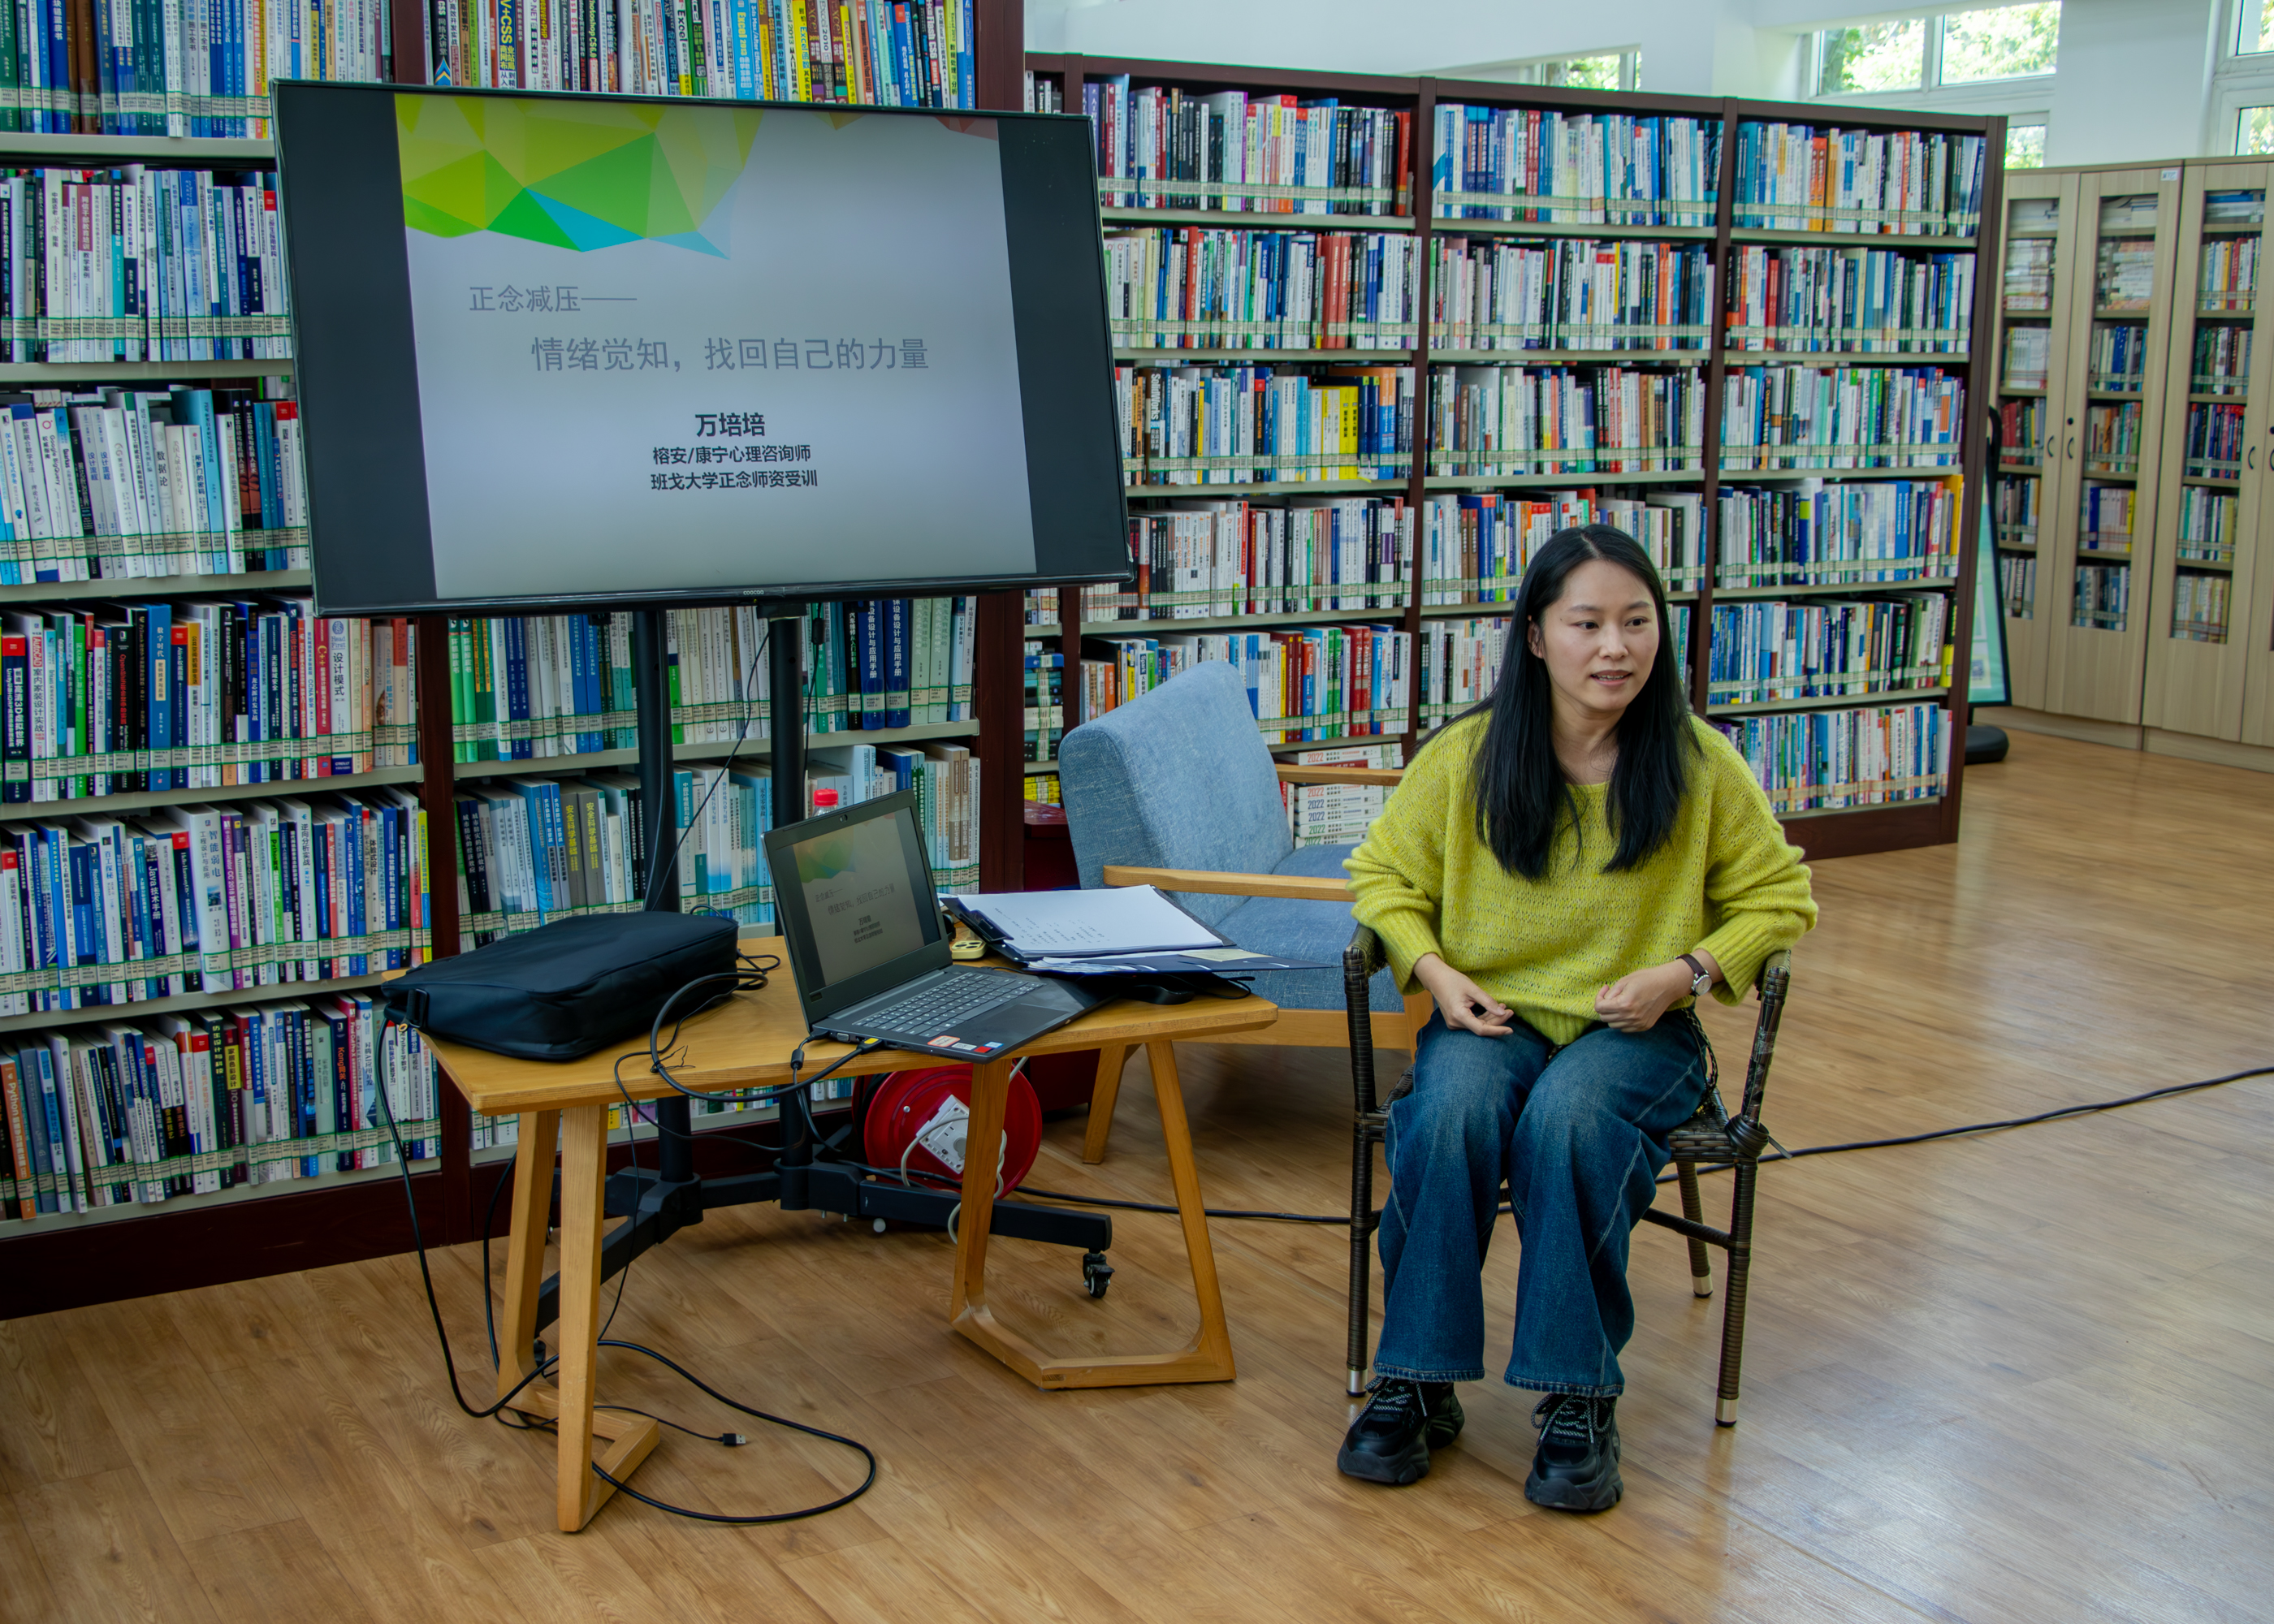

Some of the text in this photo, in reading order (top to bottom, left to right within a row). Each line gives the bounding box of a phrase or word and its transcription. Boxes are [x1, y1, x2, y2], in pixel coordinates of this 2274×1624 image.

[678, 10, 688, 41] Excel
[469, 284, 638, 313] 正念减压——
[532, 337, 929, 373] 情绪觉知，找回自己的力量
[695, 412, 766, 438] 万培培
[652, 444, 812, 466] 榕安/康宁心理咨询师
[157, 451, 169, 487] 数据论
[651, 469, 819, 491] 班戈大学正念师资受训
[33, 637, 43, 667] AutoCAD
[156, 627, 165, 658] 数字时代
[318, 645, 326, 666] C++
[333, 652, 345, 695] 设计模式
[1308, 752, 1324, 763] 2022
[1308, 787, 1325, 797] 2022
[1308, 799, 1325, 810] 2022
[1308, 811, 1325, 822] 2022
[1309, 824, 1326, 835] 2022
[1305, 836, 1321, 846] 2022
[209, 830, 222, 883] 智能弱电
[8, 1082, 21, 1116] Python
